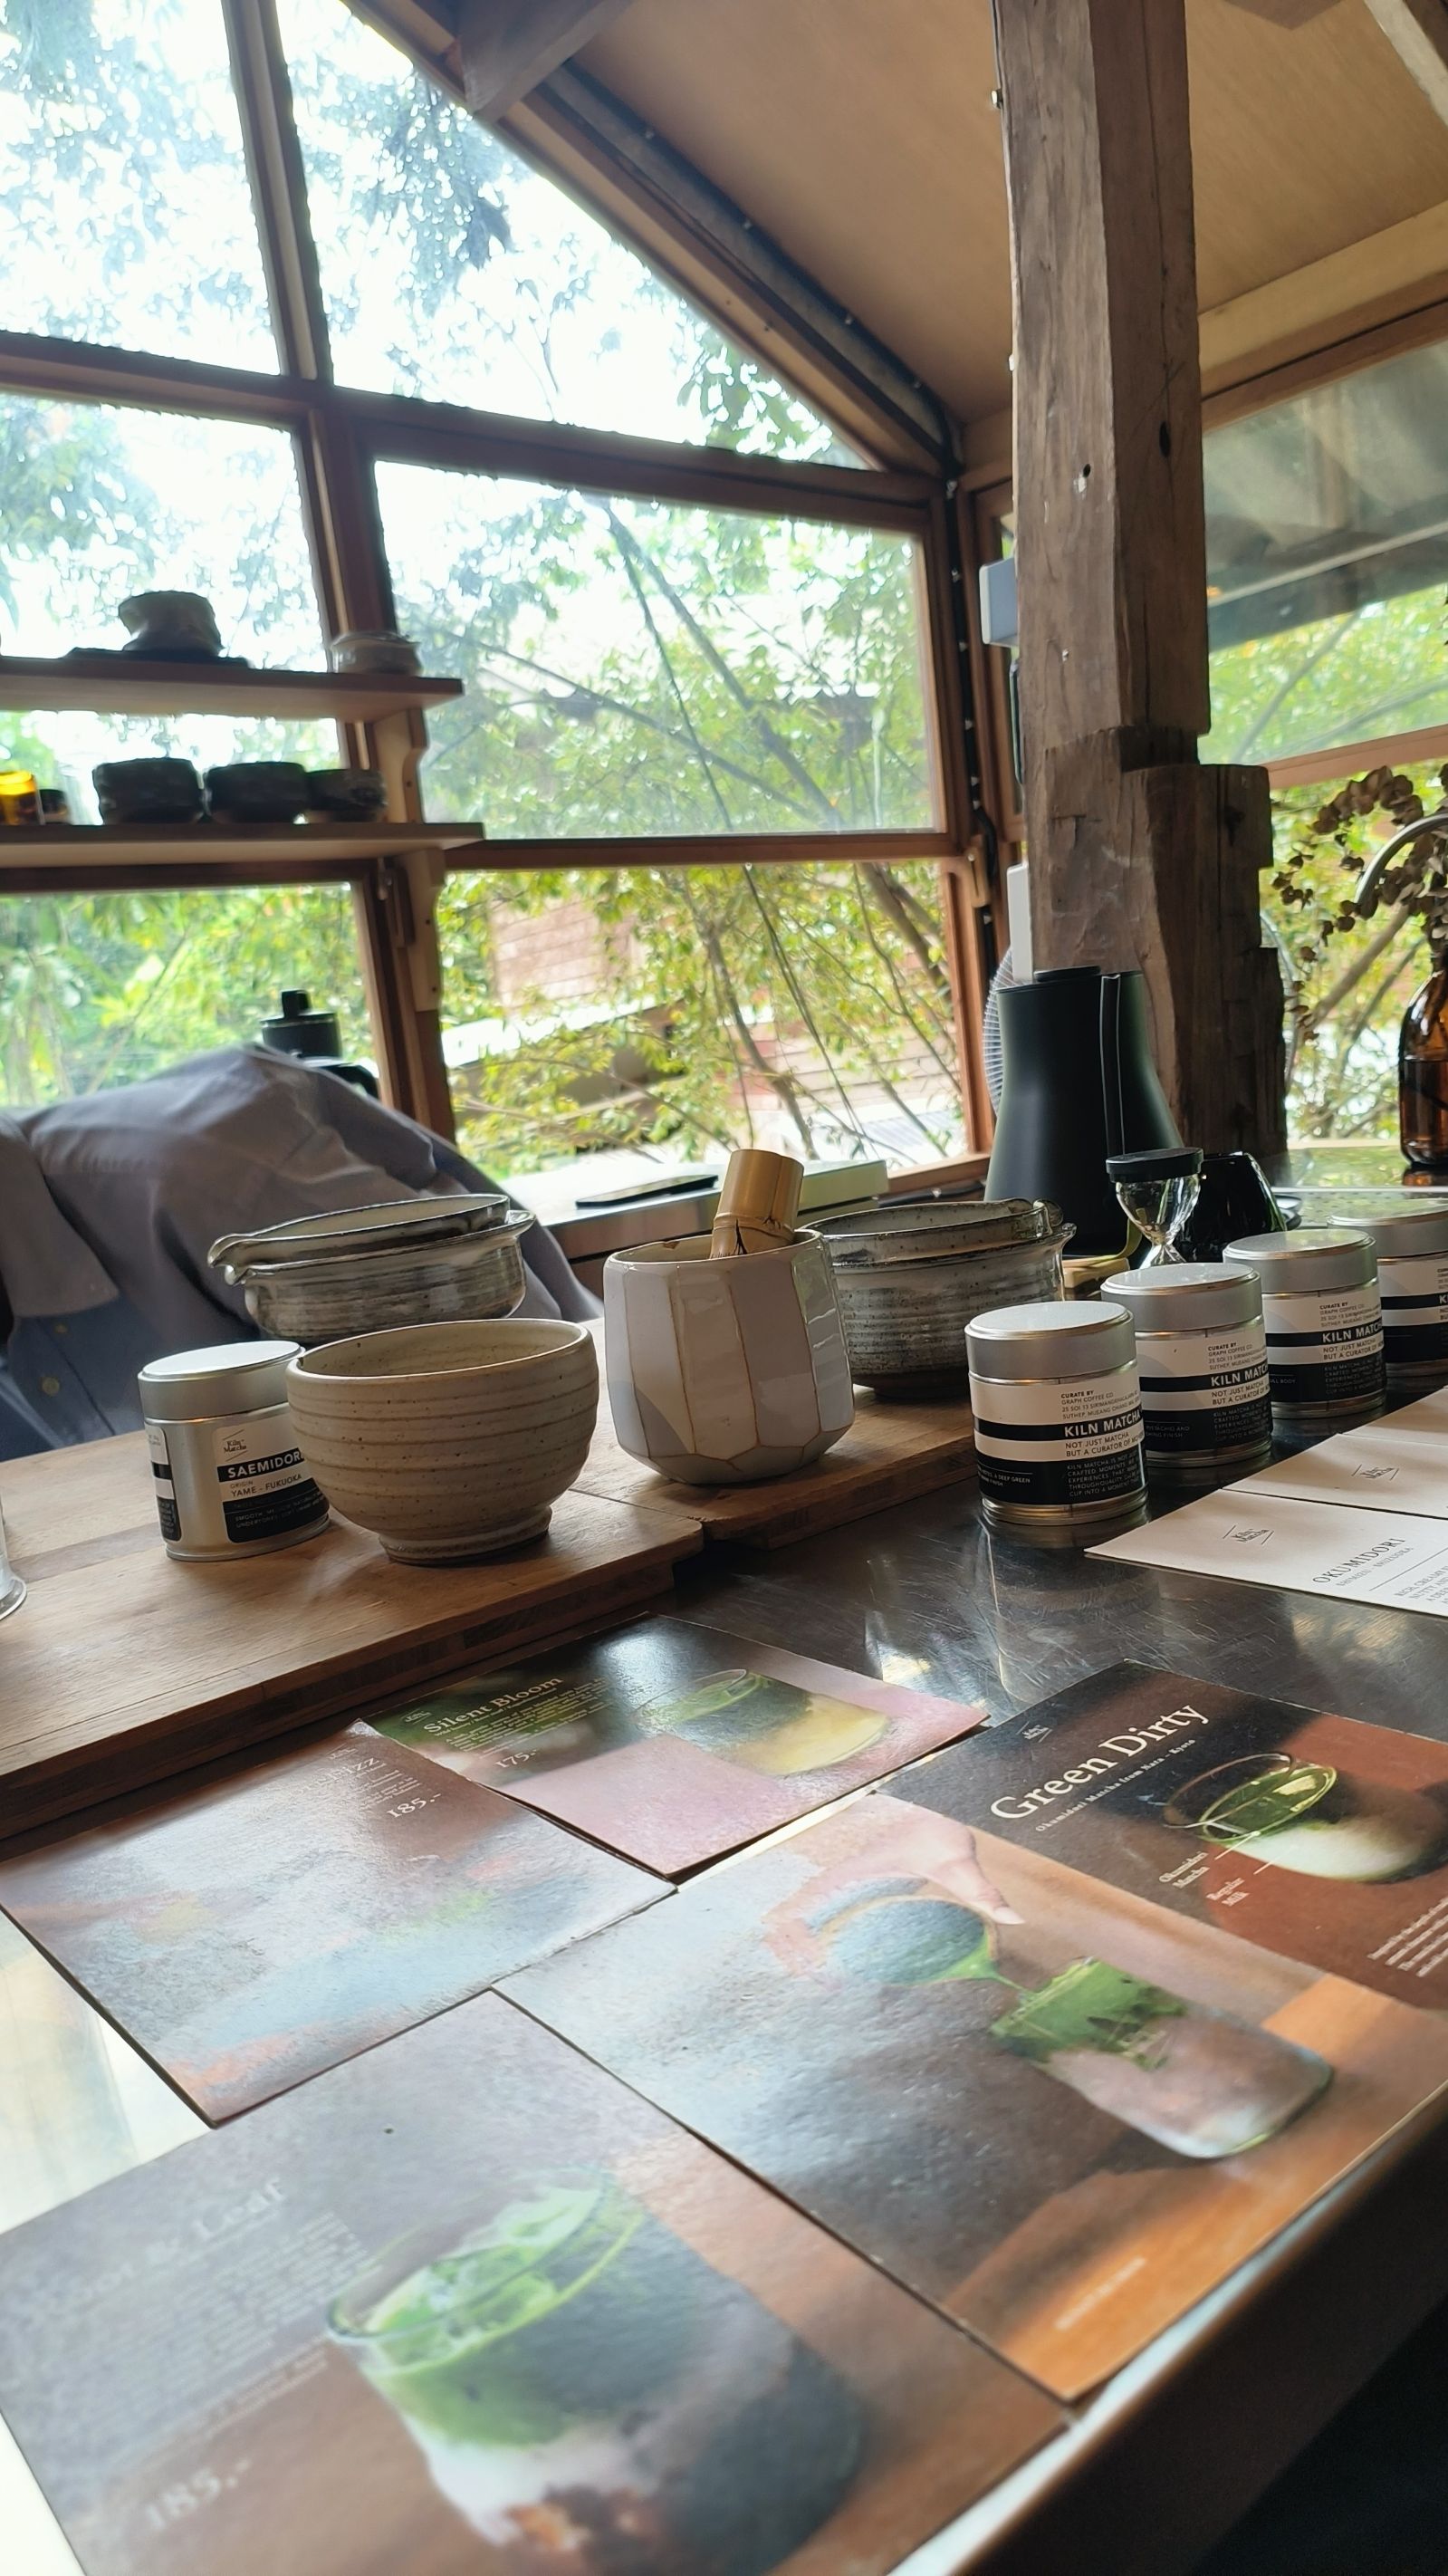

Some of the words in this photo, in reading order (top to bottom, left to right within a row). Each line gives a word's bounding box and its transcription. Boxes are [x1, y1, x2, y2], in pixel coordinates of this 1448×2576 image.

[1322, 1330, 1352, 1343] KILN
[1356, 1322, 1380, 1338] MATC
[1207, 1342, 1229, 1351] CURATE
[1339, 1342, 1356, 1351] JUST
[1345, 1346, 1371, 1358] CURATOR
[1211, 1372, 1241, 1387] KILN
[1060, 1391, 1085, 1399] CURATE
[1060, 1398, 1082, 1406] GRAPH
[1083, 1394, 1105, 1403] COFFEE
[1212, 1389, 1227, 1398] NOT
[1229, 1386, 1243, 1396] JUST
[1064, 1422, 1098, 1438] KILN
[1103, 1408, 1141, 1432] MATCHA
[1065, 1441, 1082, 1449] NOT
[1085, 1438, 1102, 1447] JUST
[1104, 1431, 1129, 1443] MATCHA
[1091, 1442, 1123, 1454] CURATOR
[1123, 1438, 1131, 1447] OF
[230, 1480, 254, 1488] ORIGIN
[231, 1485, 257, 1497] YAME
[265, 1474, 302, 1491] FUKUOKA
[1312, 1538, 1406, 1583] OKUMIDORI
[423, 1705, 494, 1735] Silent
[489, 1677, 563, 1709] Bloom
[495, 1748, 538, 1769] 175.-
[990, 1757, 1119, 1819] Green
[1098, 1705, 1210, 1757] Dirty
[1035, 1800, 1088, 1832] Okumidori
[1085, 1780, 1122, 1803] Matcha
[1121, 1769, 1145, 1783] from
[1168, 1738, 1196, 1755] Kyoto
[386, 1793, 442, 1819] 185.-
[145, 2457, 254, 2533] 185.-
